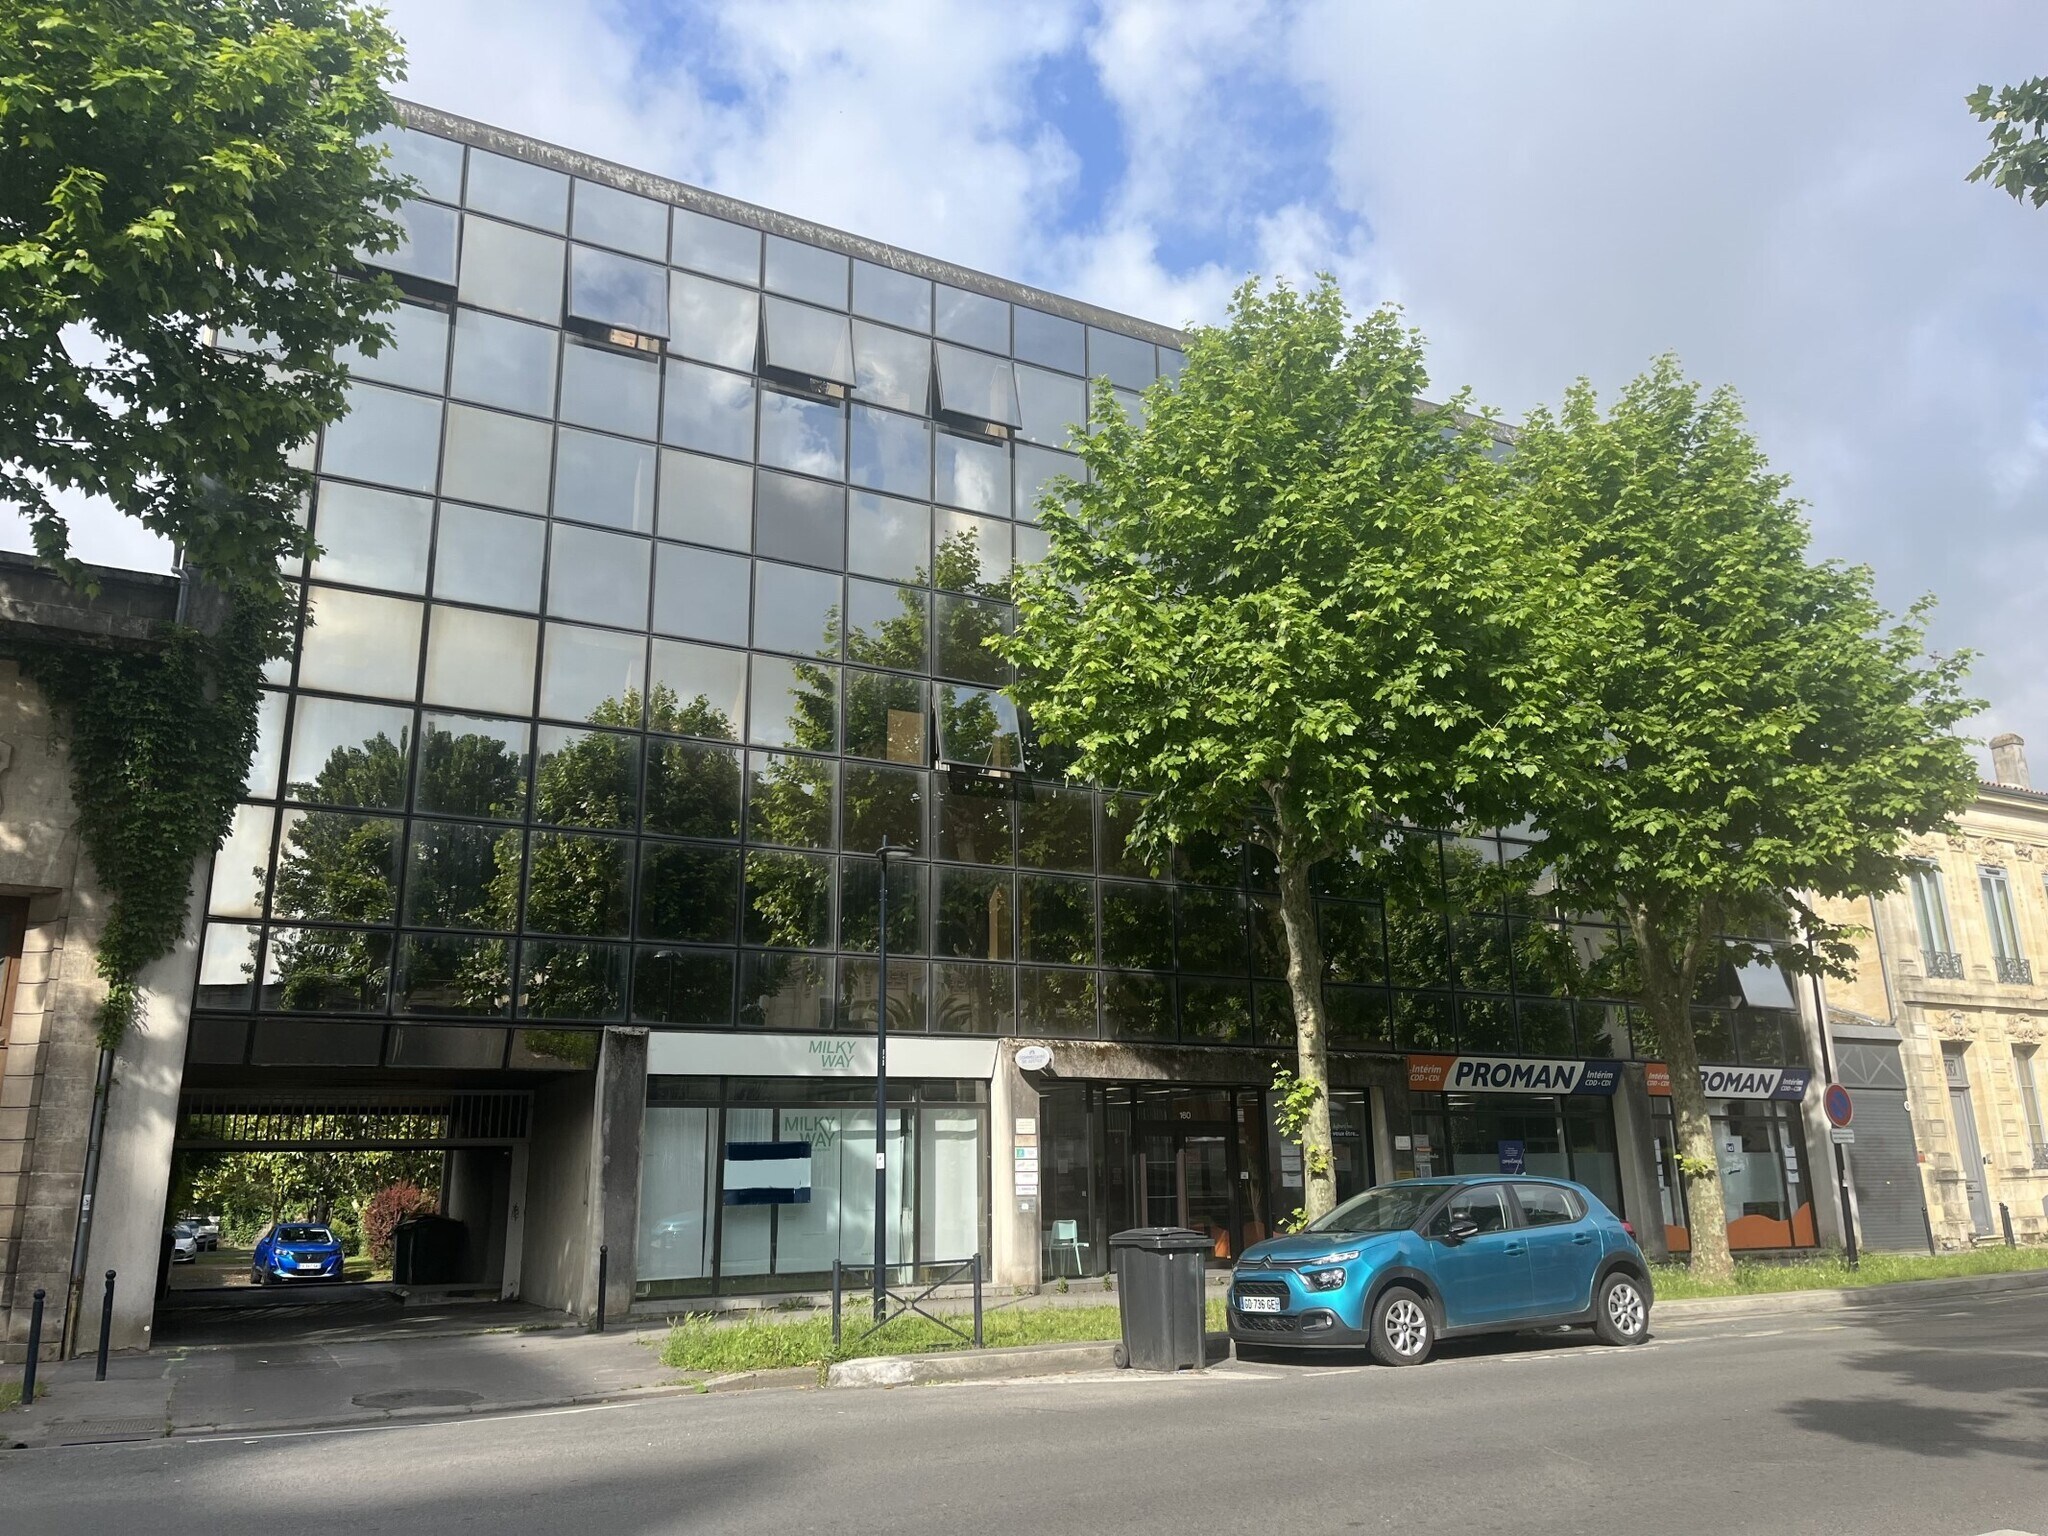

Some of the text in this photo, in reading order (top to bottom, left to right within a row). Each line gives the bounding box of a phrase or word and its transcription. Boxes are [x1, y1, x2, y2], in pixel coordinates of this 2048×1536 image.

[809, 1040, 857, 1054] MILKY
[821, 1054, 855, 1068] WAY
[1411, 1064, 1442, 1073] Intérim
[1455, 1062, 1576, 1089] PROMAN
[1587, 1070, 1614, 1079] Intérim
[1700, 1071, 1775, 1093] ROMAN
[784, 1116, 836, 1132] MILKY
[800, 1132, 836, 1148] WAY
